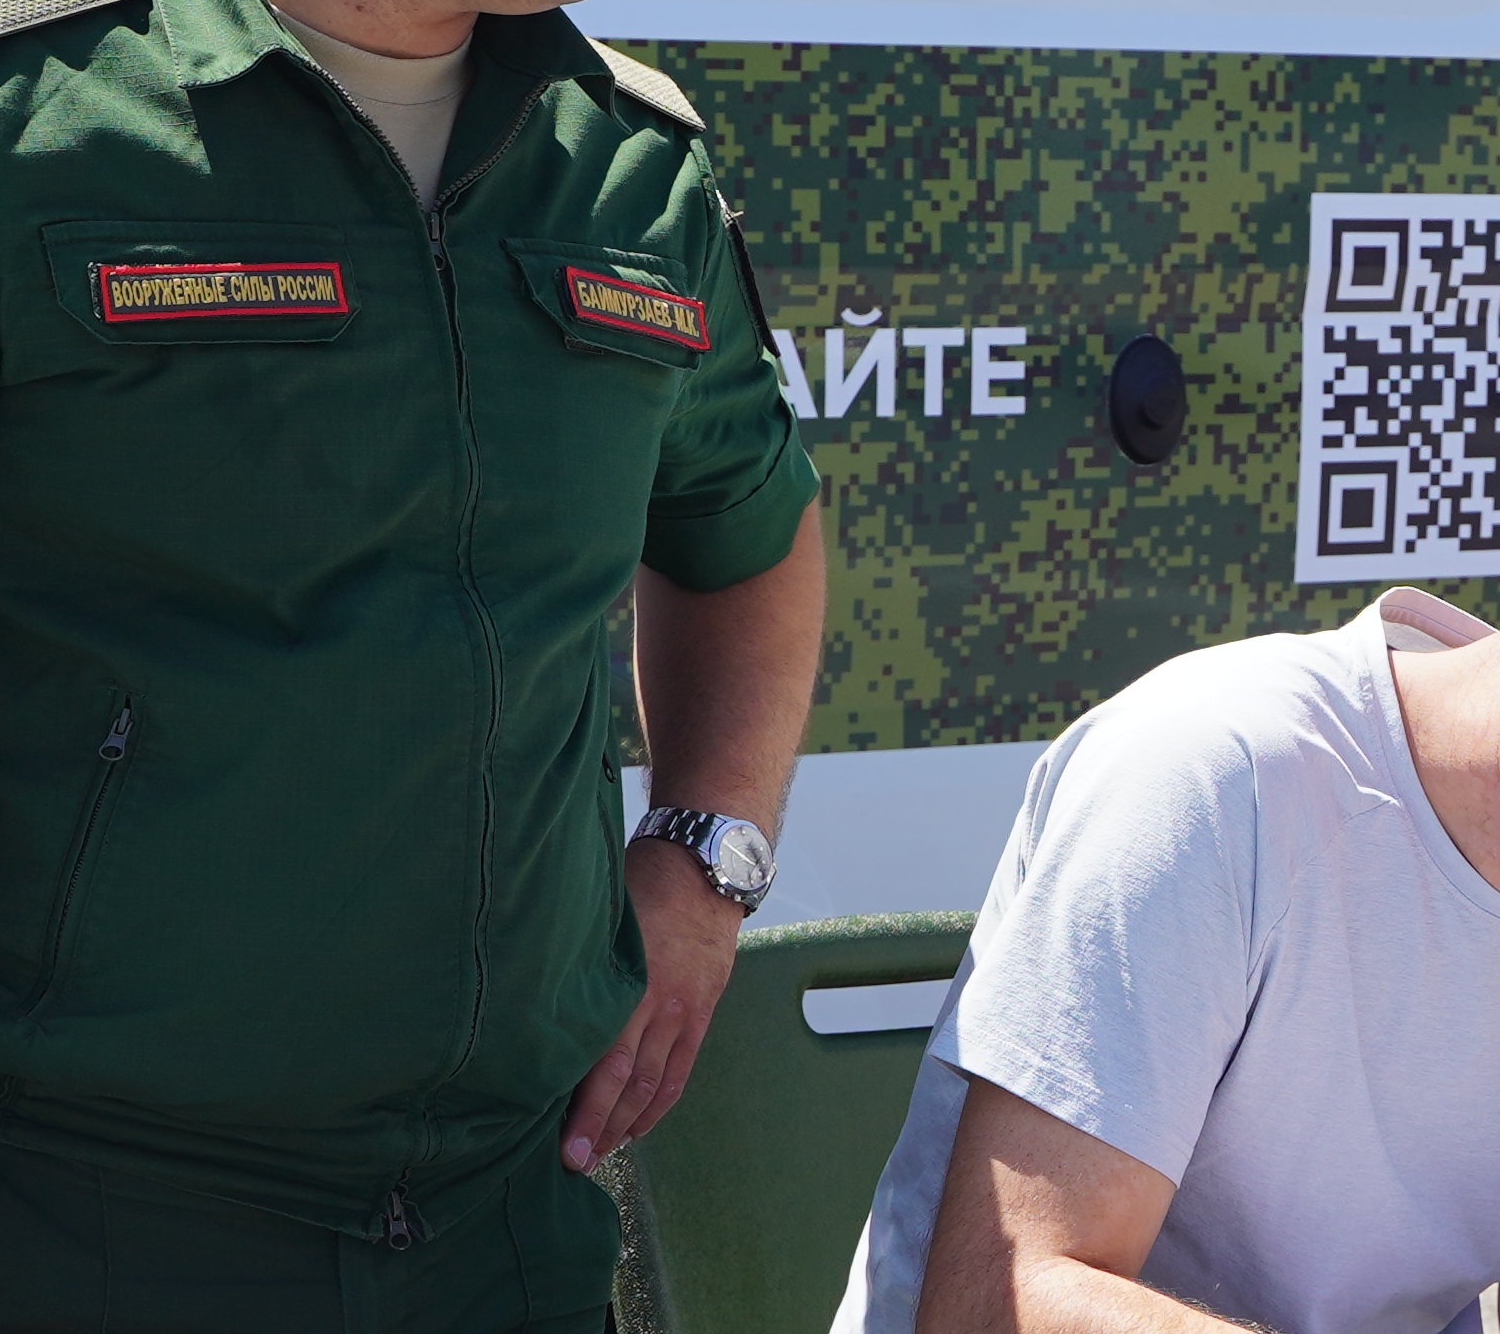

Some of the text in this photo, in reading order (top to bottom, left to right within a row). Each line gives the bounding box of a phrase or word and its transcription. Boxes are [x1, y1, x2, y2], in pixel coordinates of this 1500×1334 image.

[111, 274, 337, 309] ВООРУЖЕННЫЕ СИЛЫ РОССИИ
[576, 280, 673, 328] БАЙМУРЗАЕВ
